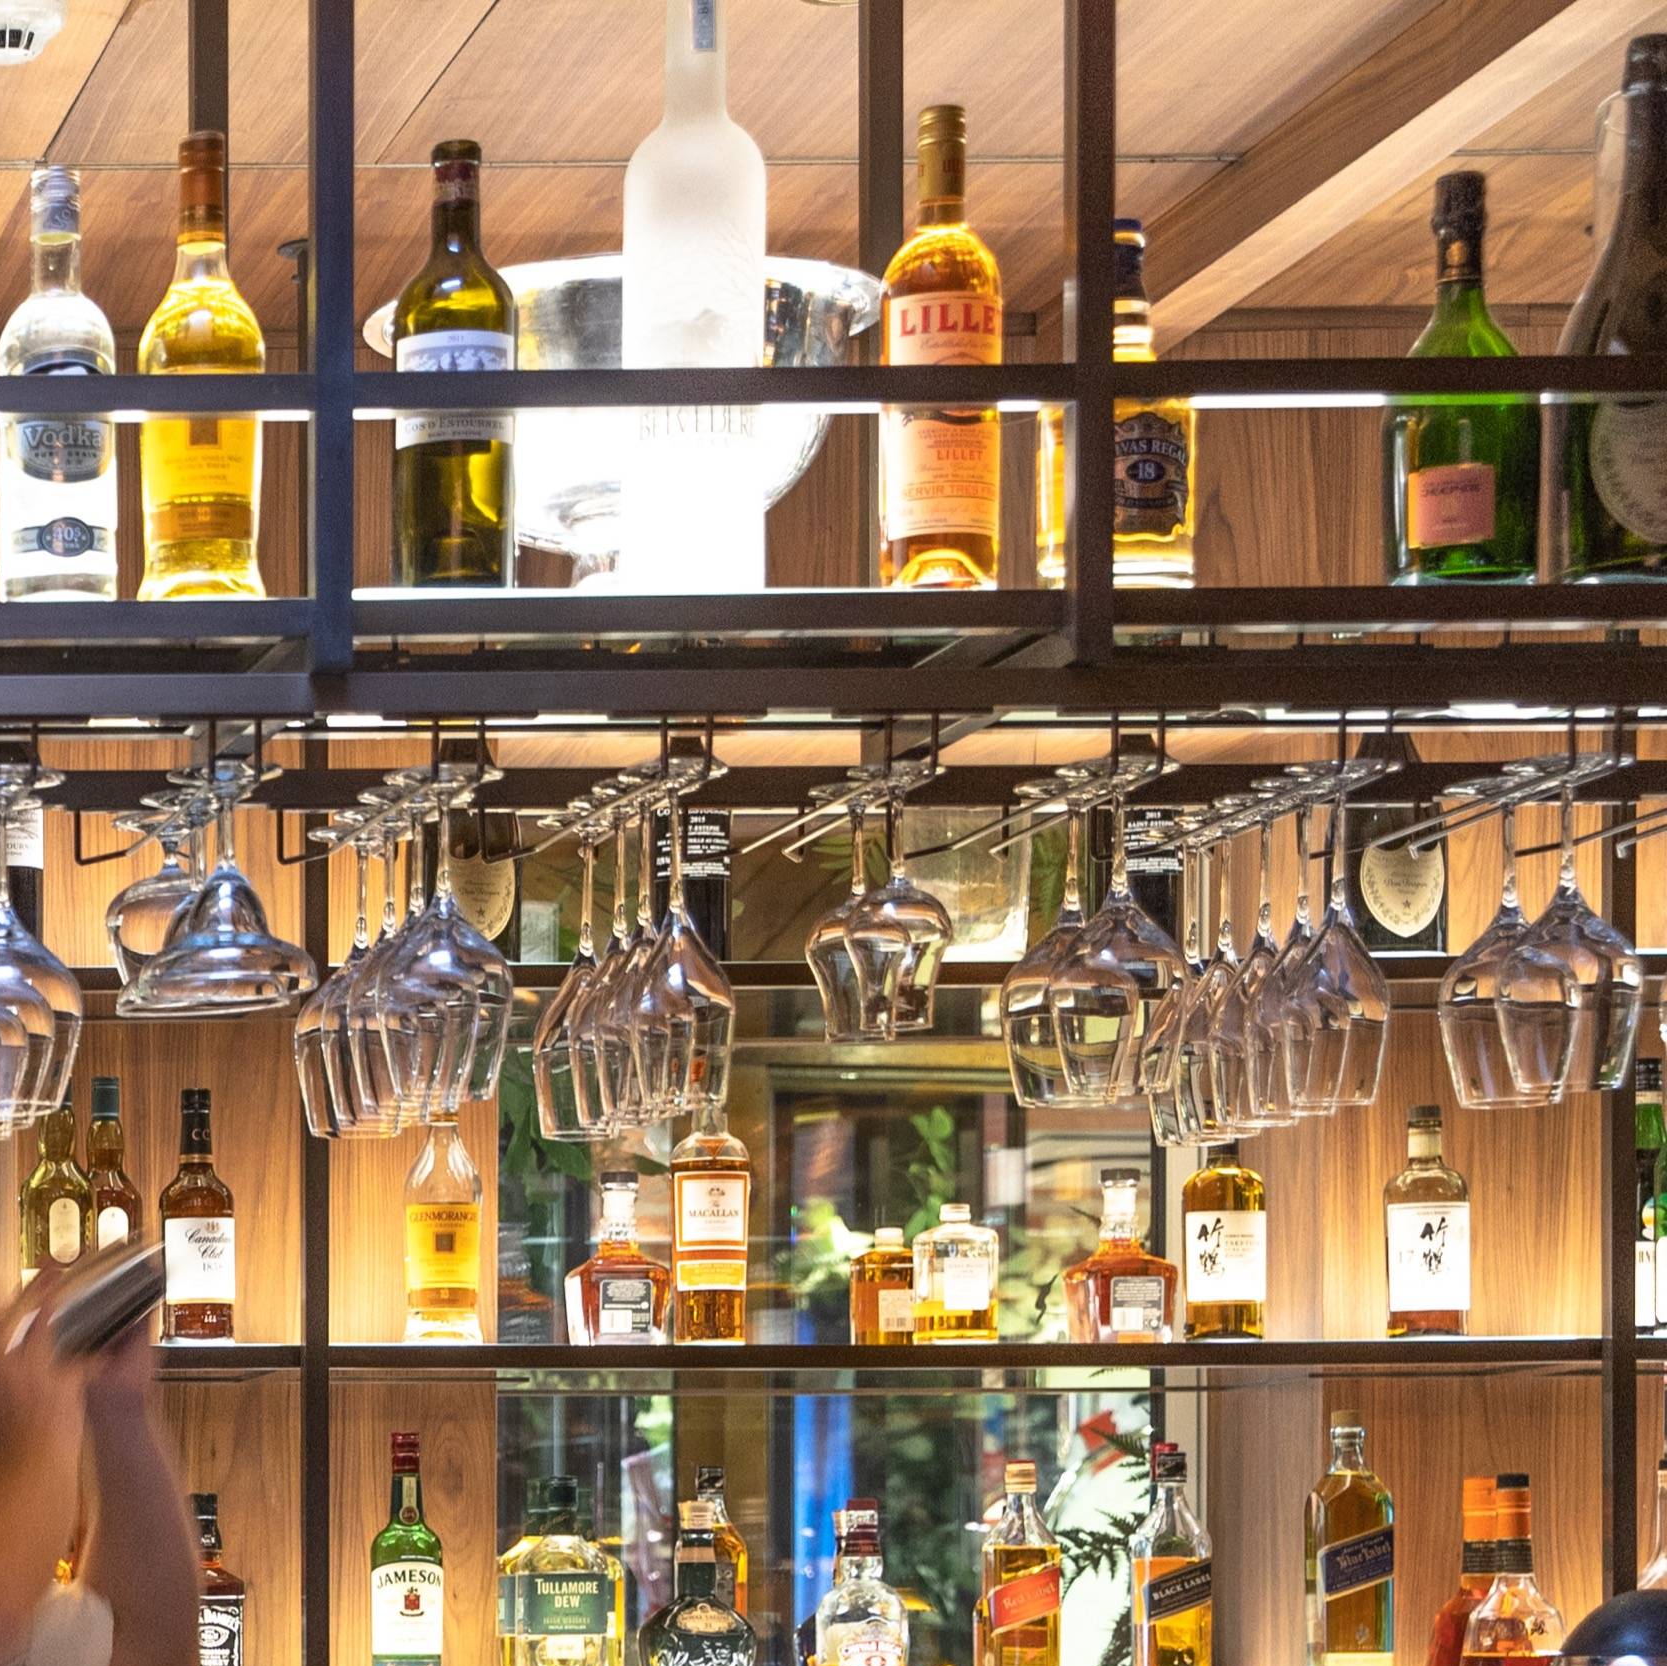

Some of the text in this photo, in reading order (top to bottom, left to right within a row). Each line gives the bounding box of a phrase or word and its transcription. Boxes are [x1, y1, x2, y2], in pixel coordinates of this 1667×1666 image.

[900, 302, 995, 338] LILLE
[21, 424, 103, 449] Vodka
[935, 449, 983, 461] LILLET
[1137, 462, 1156, 479] 18
[687, 1208, 740, 1219] MACALLAN
[376, 1568, 442, 1590] JAMESON
[534, 1577, 599, 1594] TULLAMORE
[1151, 1573, 1213, 1602] BLACK LABEL
[553, 1594, 581, 1609] DEW
